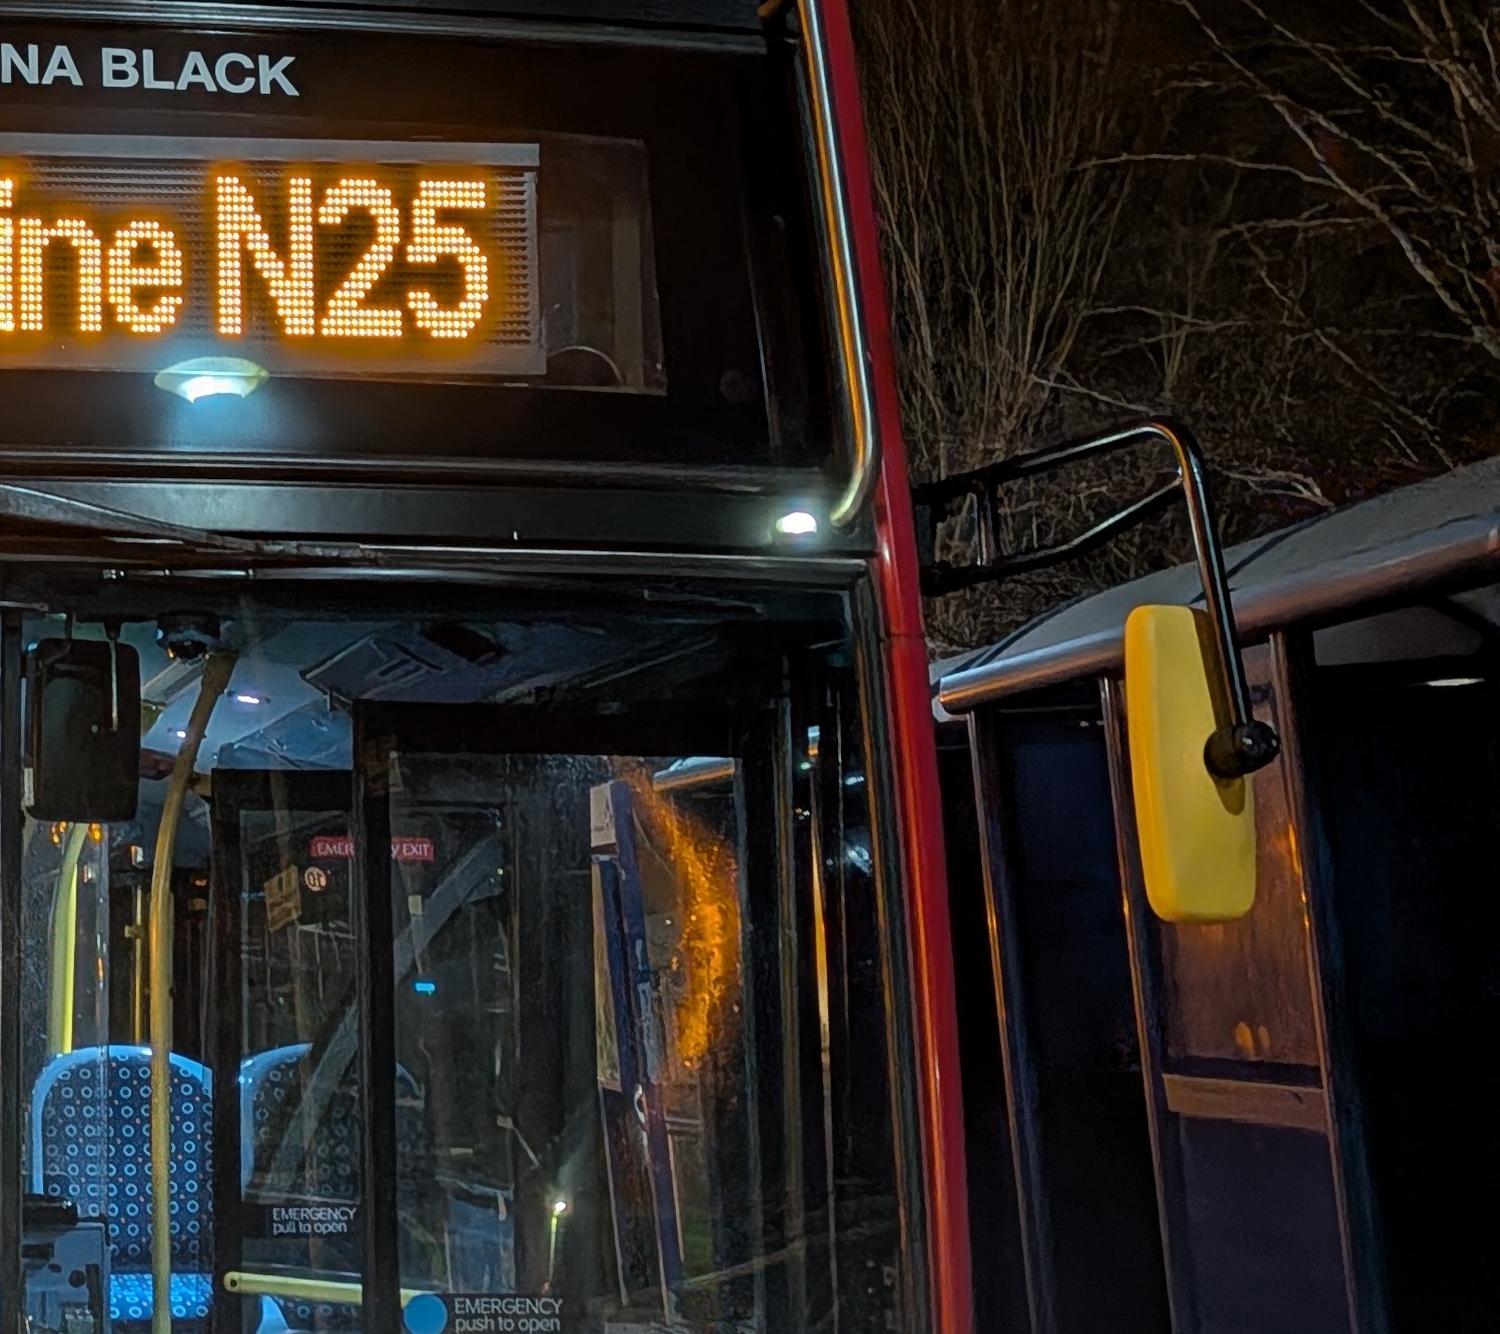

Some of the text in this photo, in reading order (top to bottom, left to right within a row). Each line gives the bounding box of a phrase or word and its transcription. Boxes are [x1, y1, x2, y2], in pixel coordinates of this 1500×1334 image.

[102, 47, 300, 97] BLACK
[215, 174, 490, 339] N25
[402, 842, 430, 857] EXIT
[272, 1207, 357, 1221] EMERGENCY
[272, 1221, 348, 1236] pull to open
[454, 1297, 563, 1315] EMERGENCY
[455, 1315, 561, 1334] push to open
